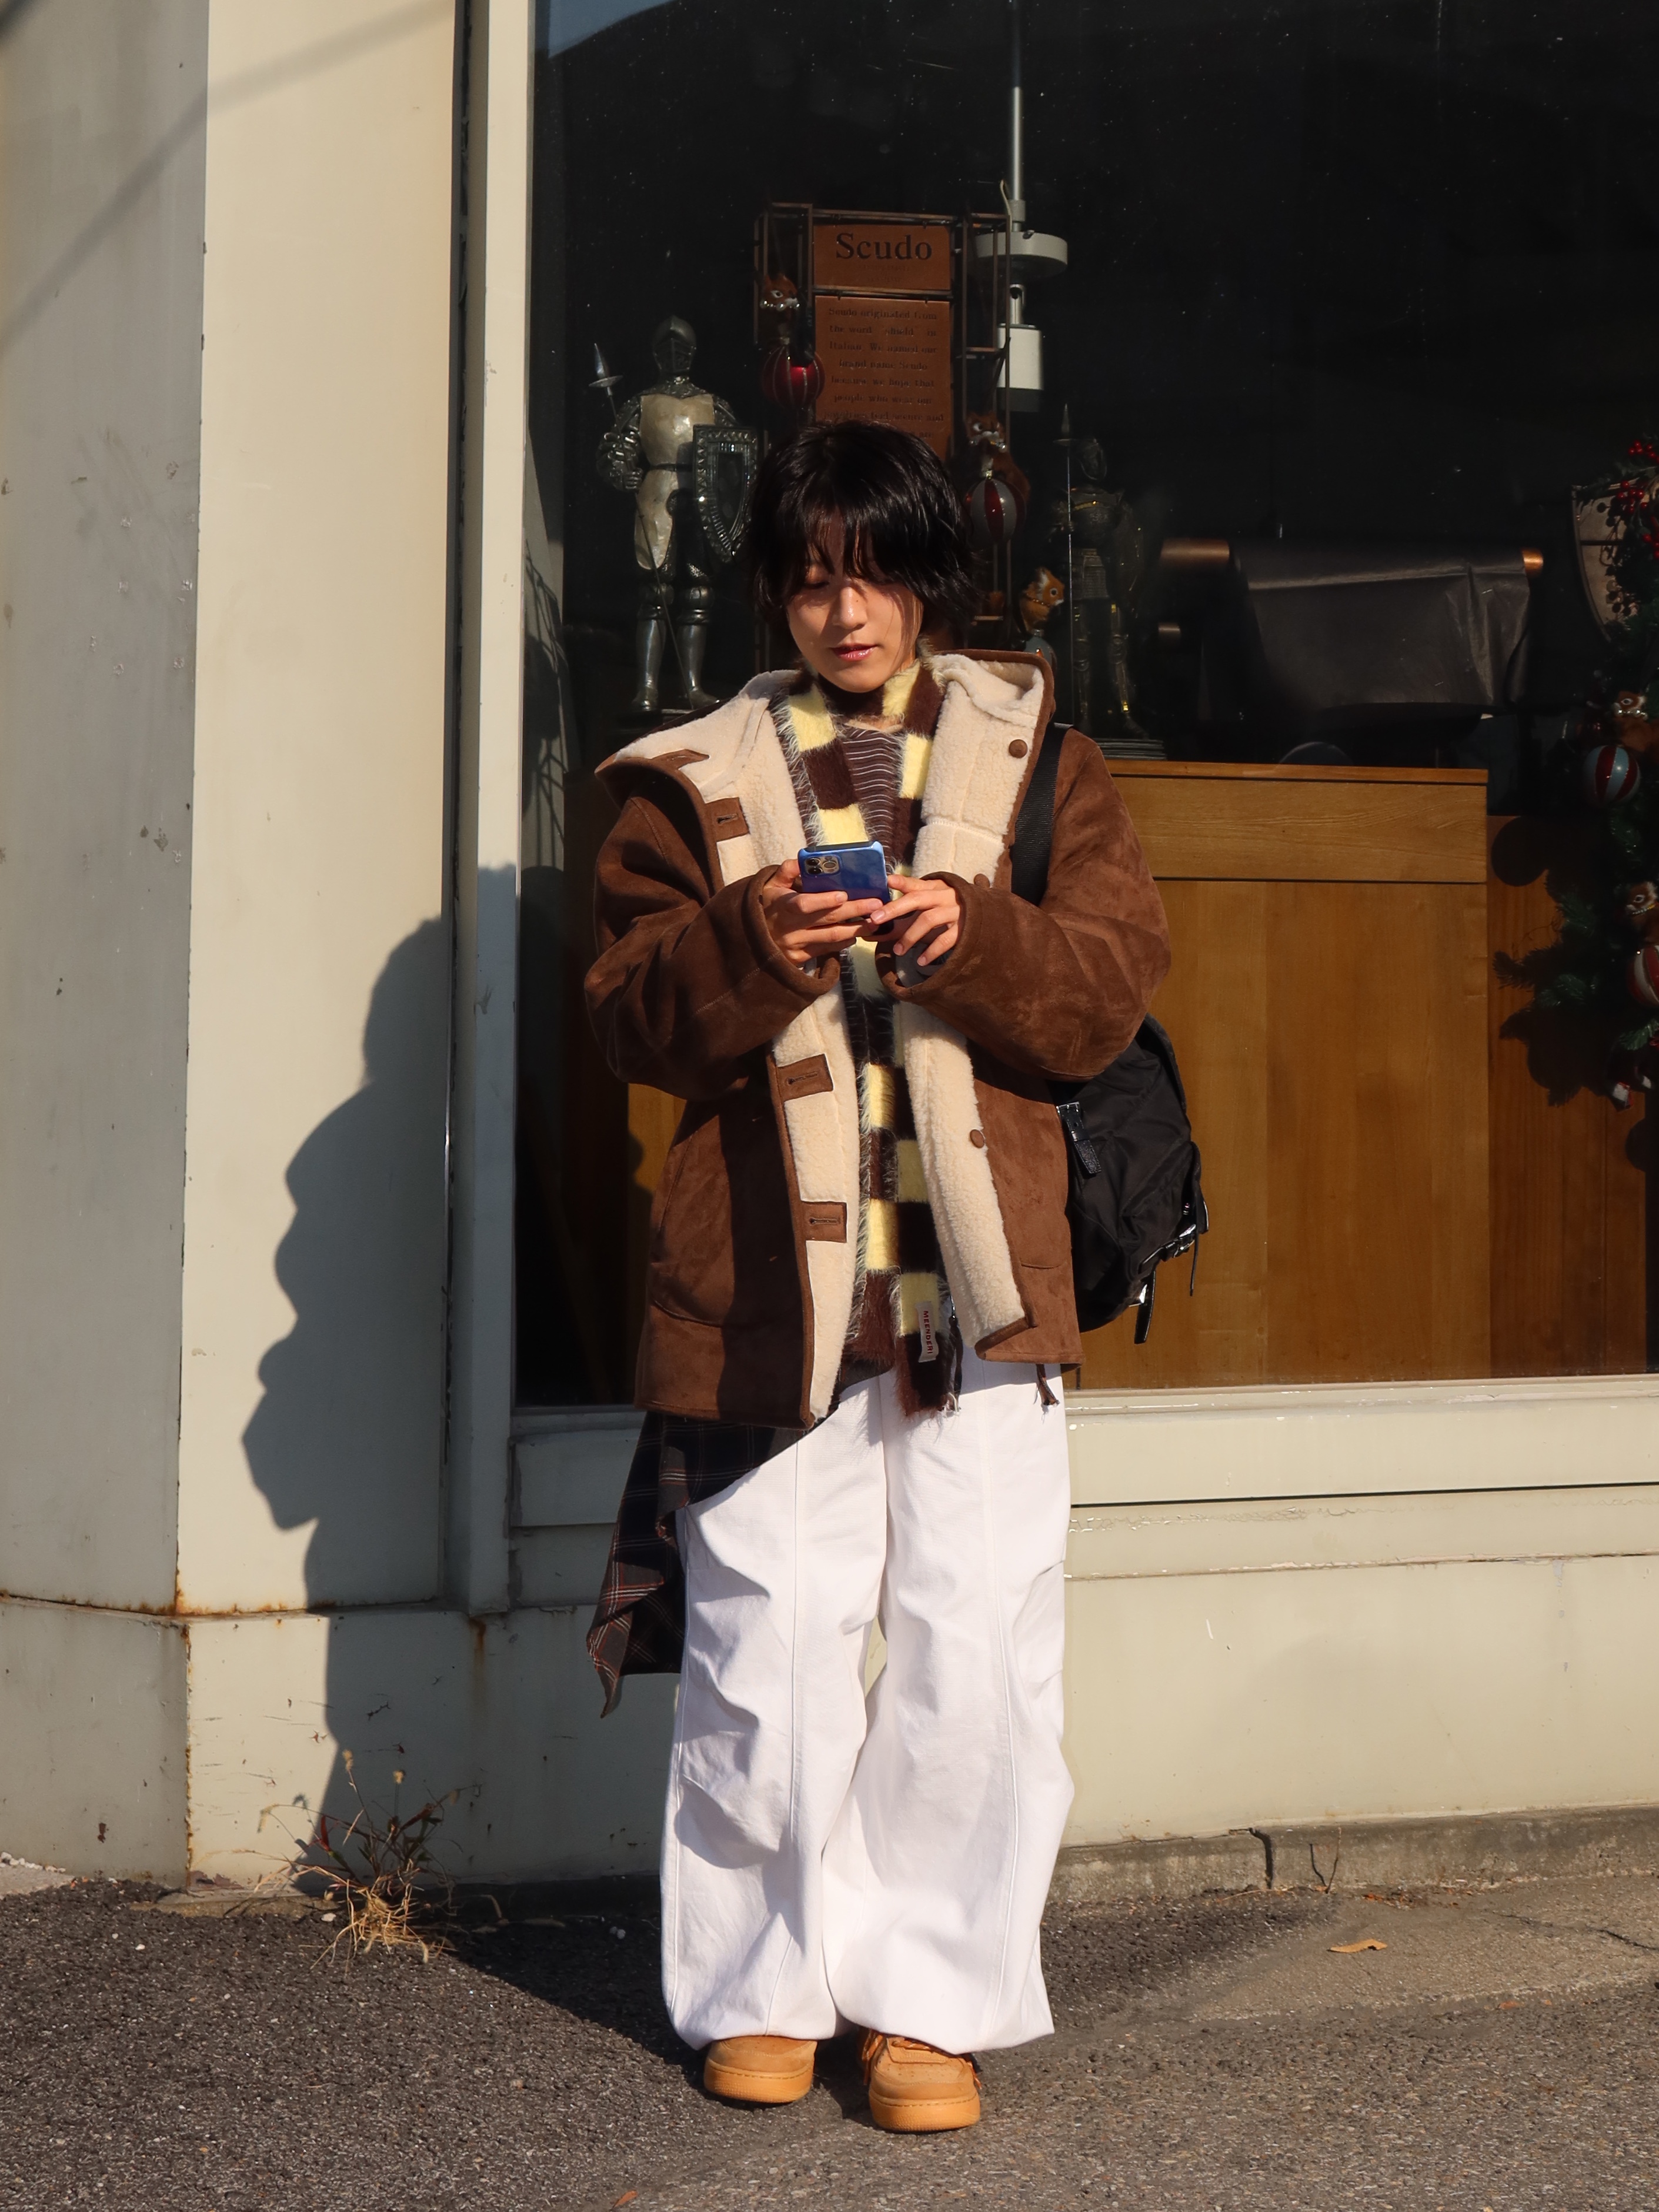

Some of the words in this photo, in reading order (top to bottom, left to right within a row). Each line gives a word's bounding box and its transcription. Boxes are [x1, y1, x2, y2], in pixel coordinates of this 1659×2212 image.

[836, 232, 932, 260] Scudo
[829, 308, 857, 316] Scudo
[860, 309, 910, 319] originated
[914, 311, 937, 319] from
[887, 345, 918, 353] named
[839, 358, 866, 367] brand
[899, 361, 927, 370] Scudo
[832, 376, 868, 384] because
[889, 378, 912, 388] hope
[914, 379, 934, 387] that
[834, 393, 864, 403] people
[870, 411, 889, 419] feel
[927, 413, 944, 422] and
[923, 1310, 933, 1354] MEENDERI
